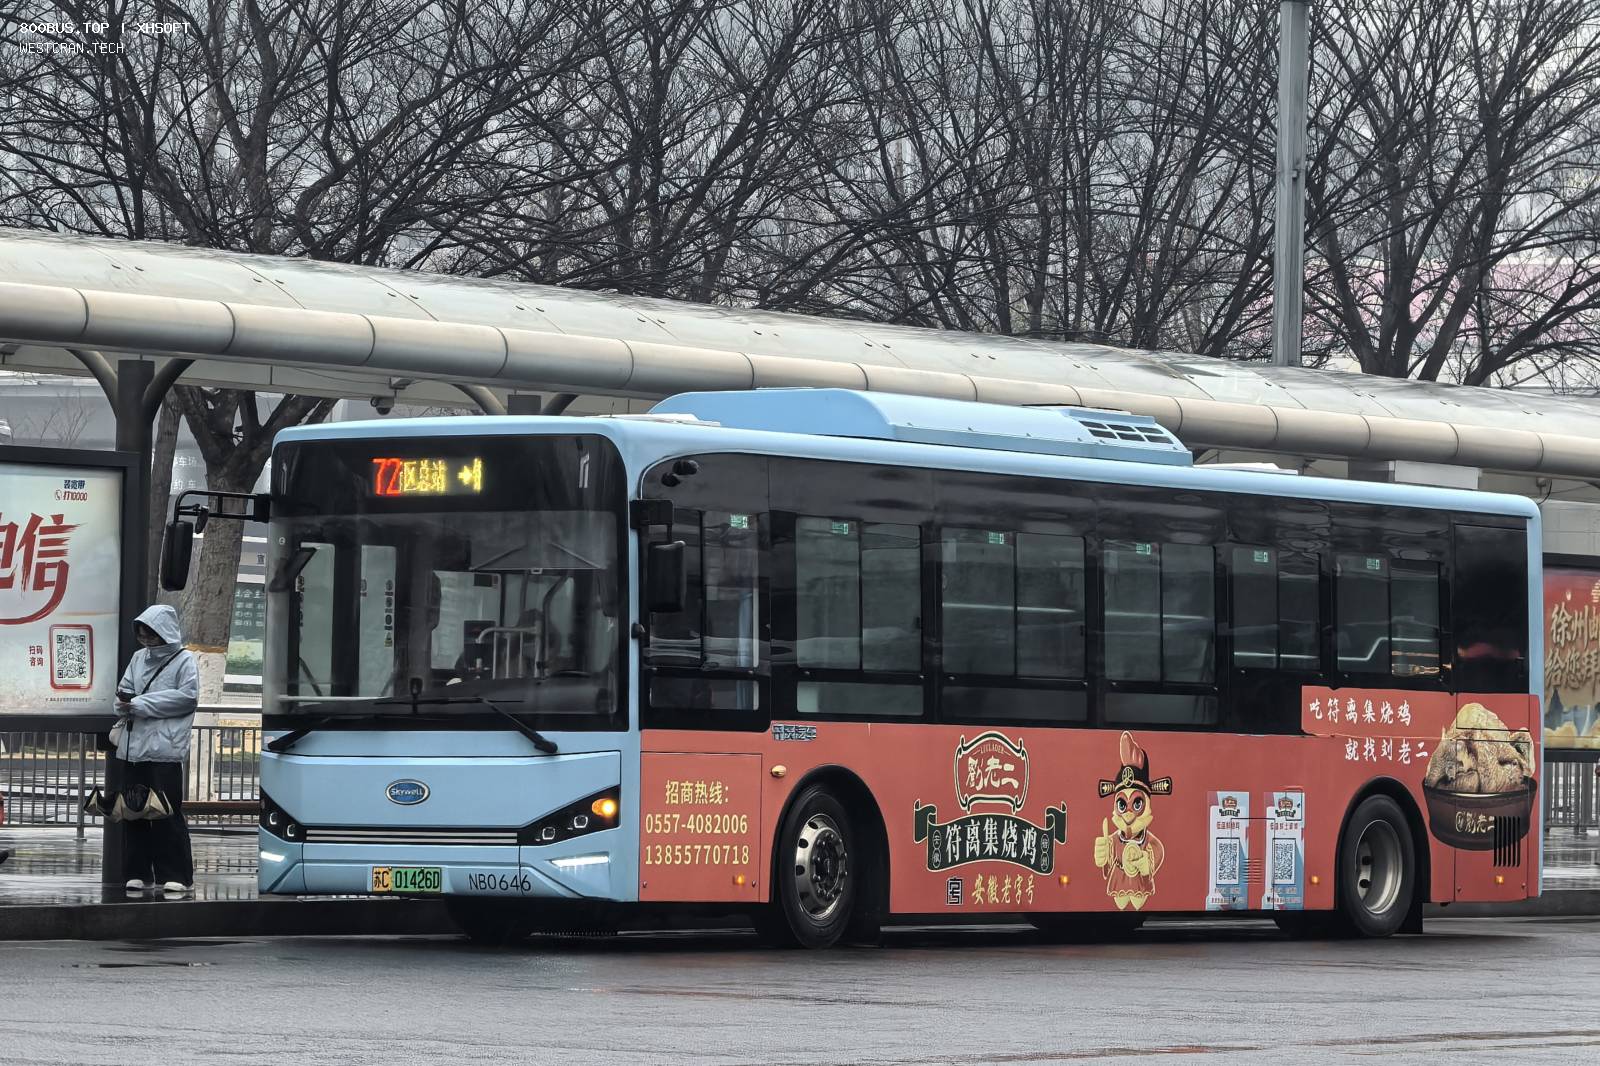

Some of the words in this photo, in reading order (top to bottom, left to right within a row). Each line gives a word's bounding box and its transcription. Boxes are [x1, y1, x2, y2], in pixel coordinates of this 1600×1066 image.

[373, 458, 401, 495] 72
[1308, 697, 1412, 727] 吃符离集烧鸡
[1344, 738, 1429, 765] 就找刘老二
[645, 813, 748, 834] 0557-4082006
[645, 845, 750, 865] 13855770718
[945, 817, 1038, 865] 符离集烧鸡
[971, 873, 1035, 905] 安徽老字号
